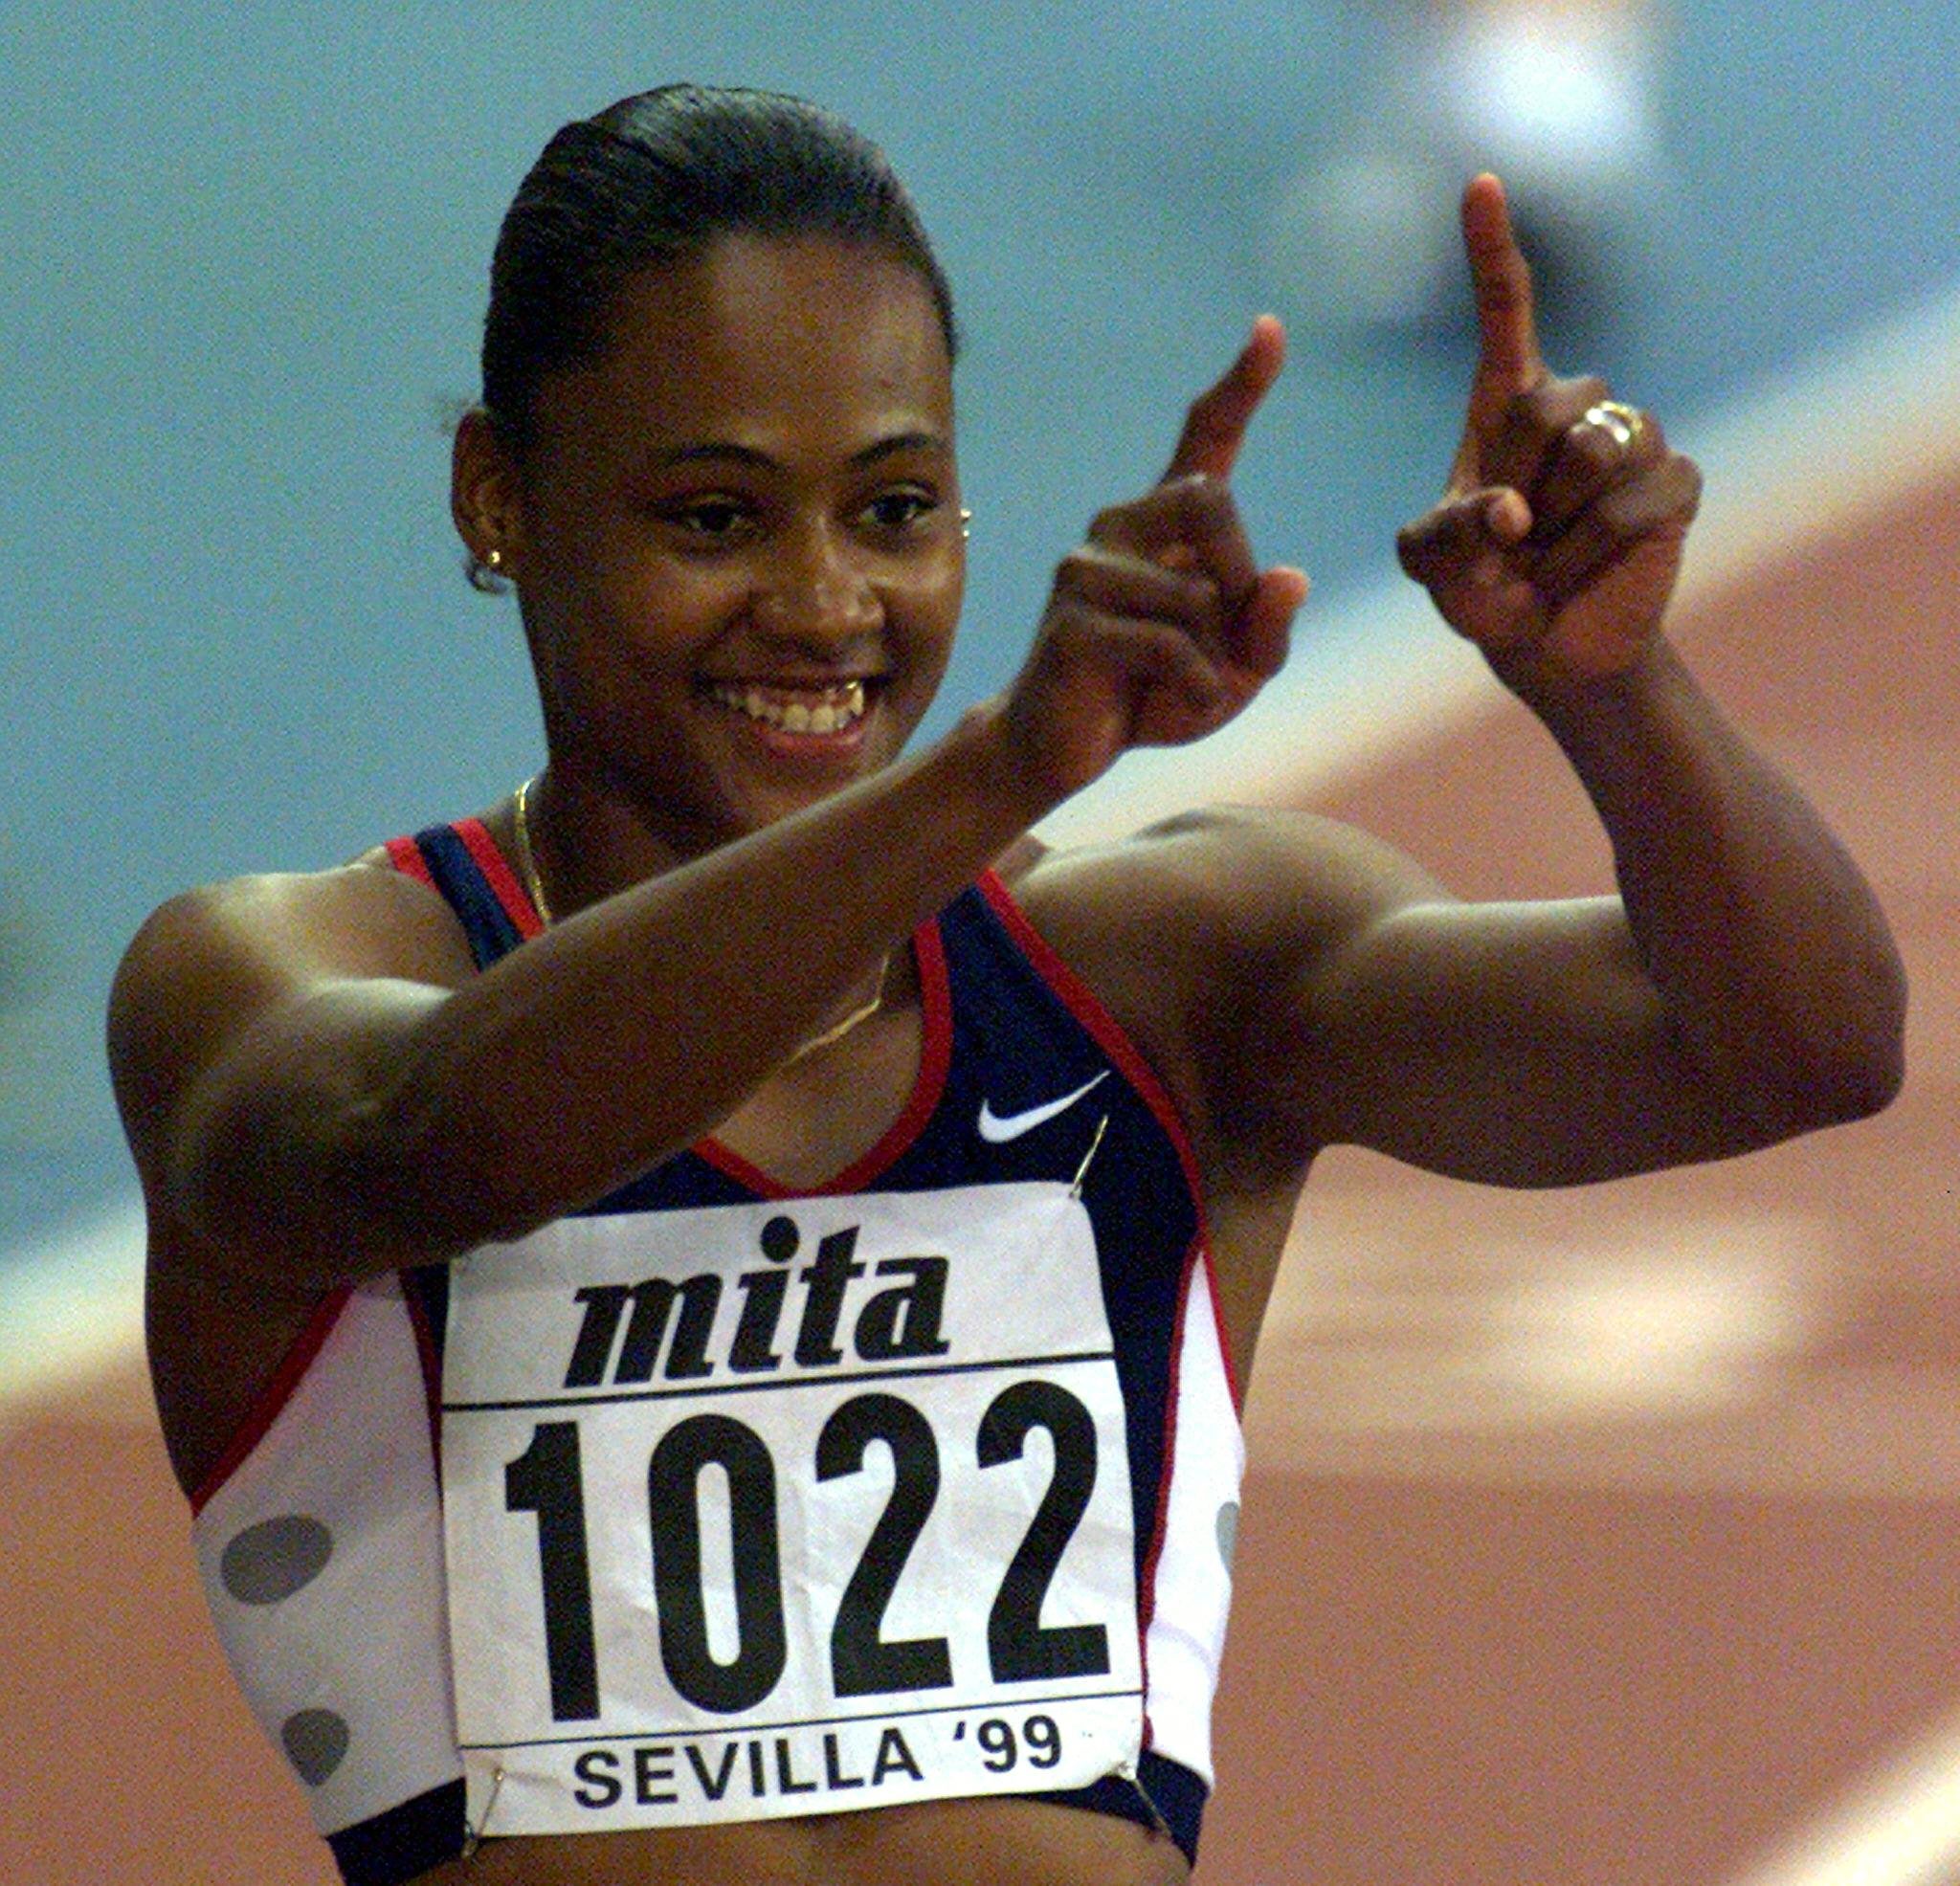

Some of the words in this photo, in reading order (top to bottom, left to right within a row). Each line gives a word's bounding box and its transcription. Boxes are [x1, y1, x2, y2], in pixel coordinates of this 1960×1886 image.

[564, 1216, 949, 1389] mita
[504, 1381, 1110, 1721] 1022
[574, 1728, 924, 1809] SEVILLA
[953, 1714, 1061, 1772] '99
